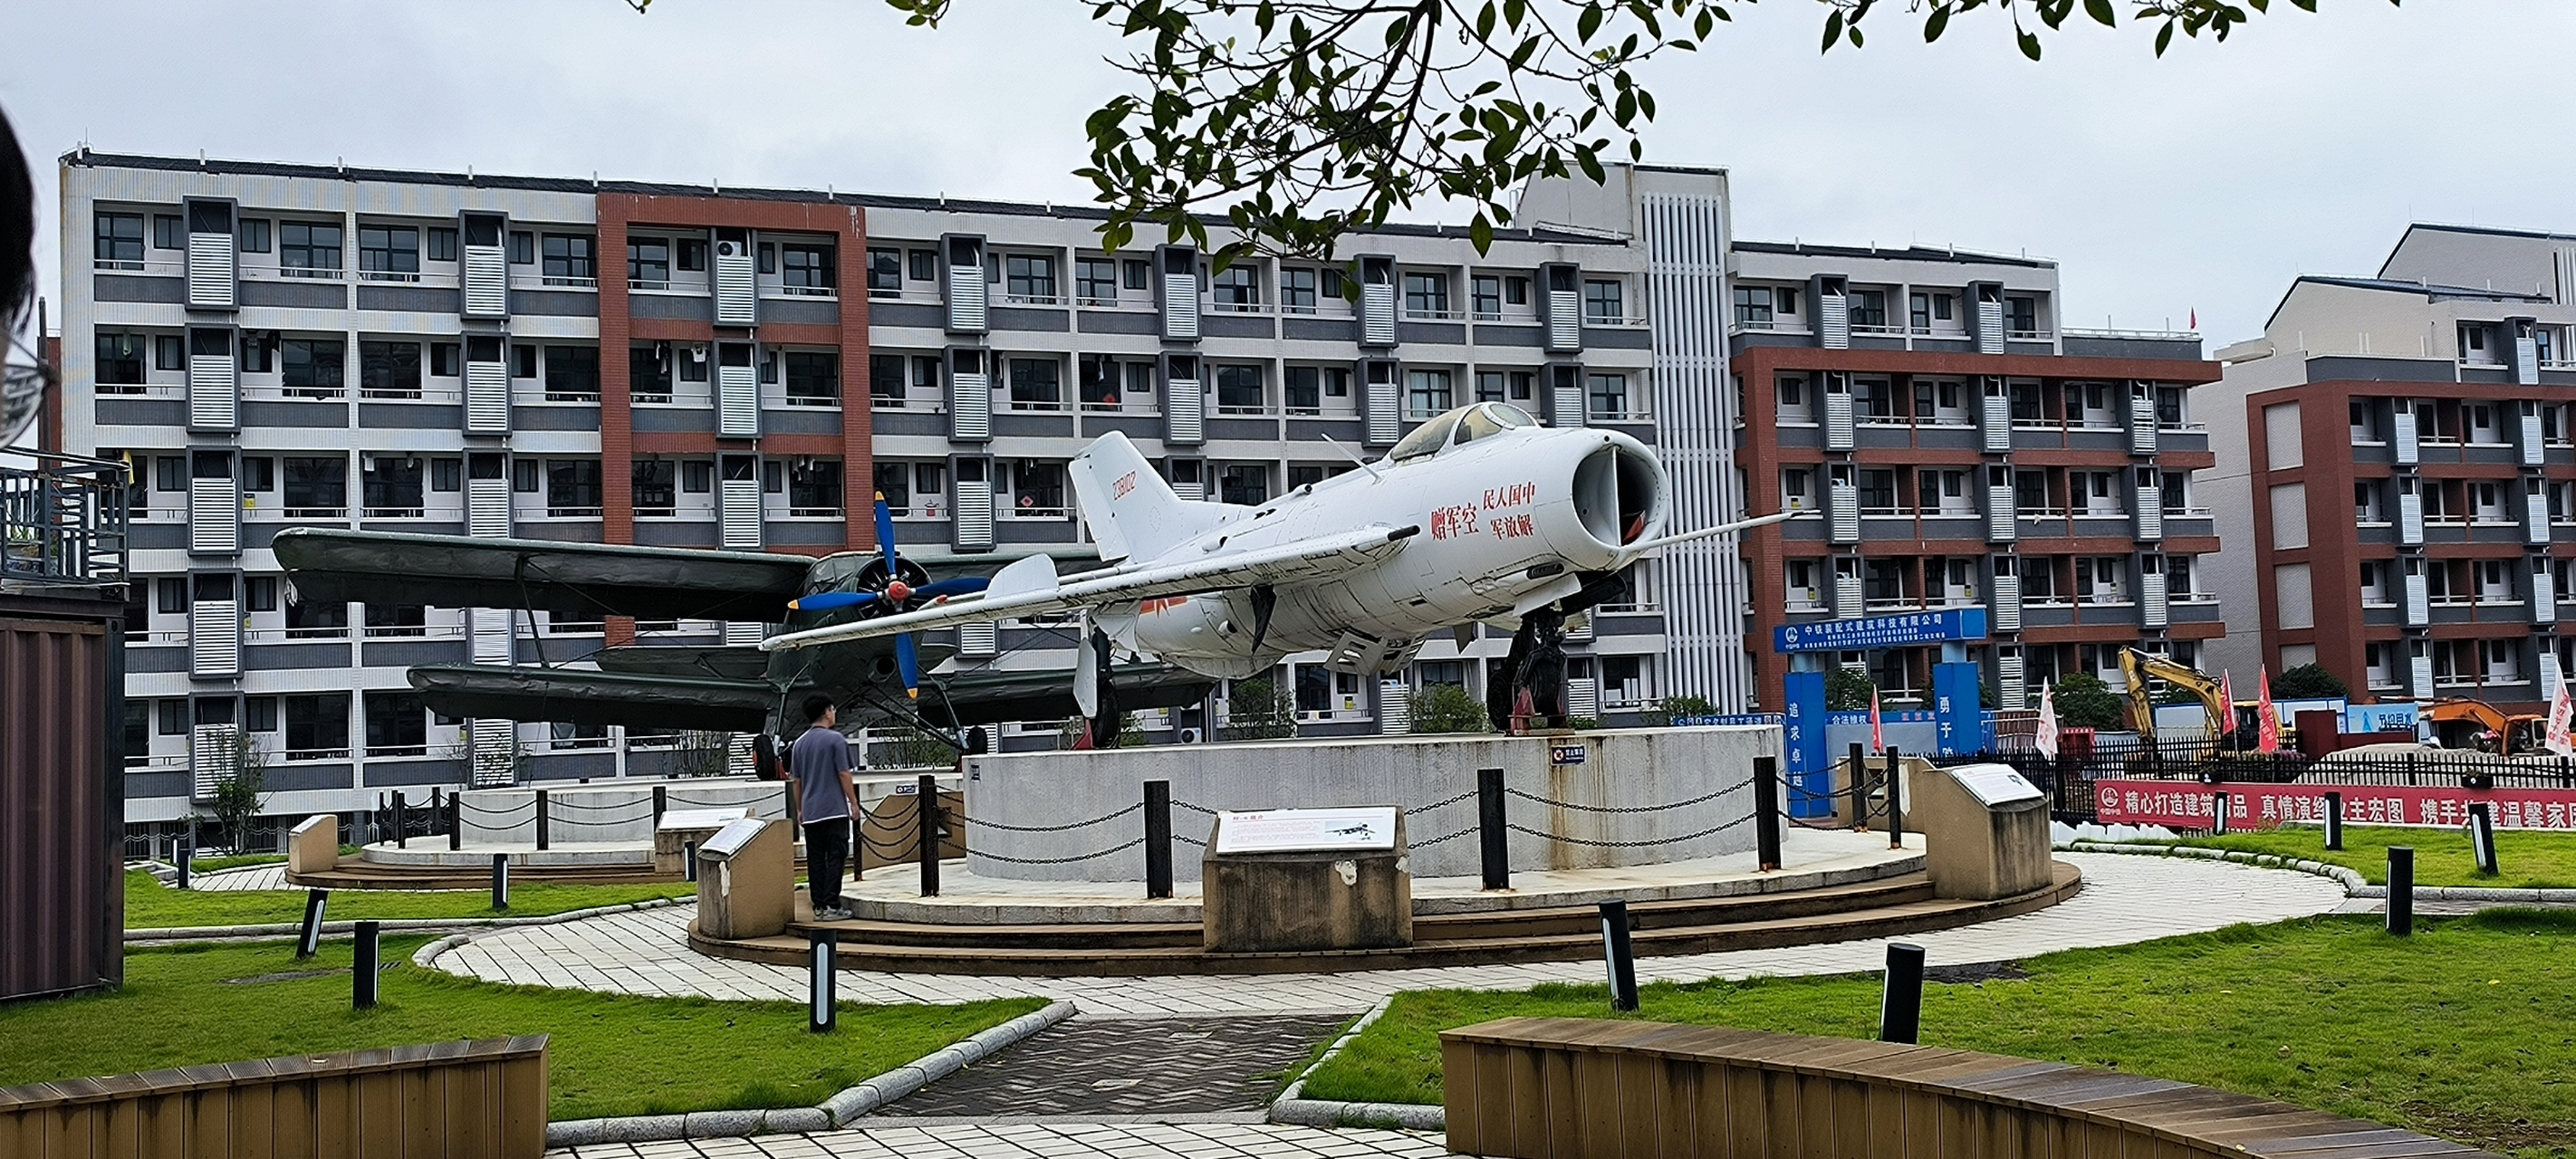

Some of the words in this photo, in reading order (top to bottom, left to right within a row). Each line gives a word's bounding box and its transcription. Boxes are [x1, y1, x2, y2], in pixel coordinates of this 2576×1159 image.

[1804, 613, 1942, 637] 中铁装配式建筑科技有限公司
